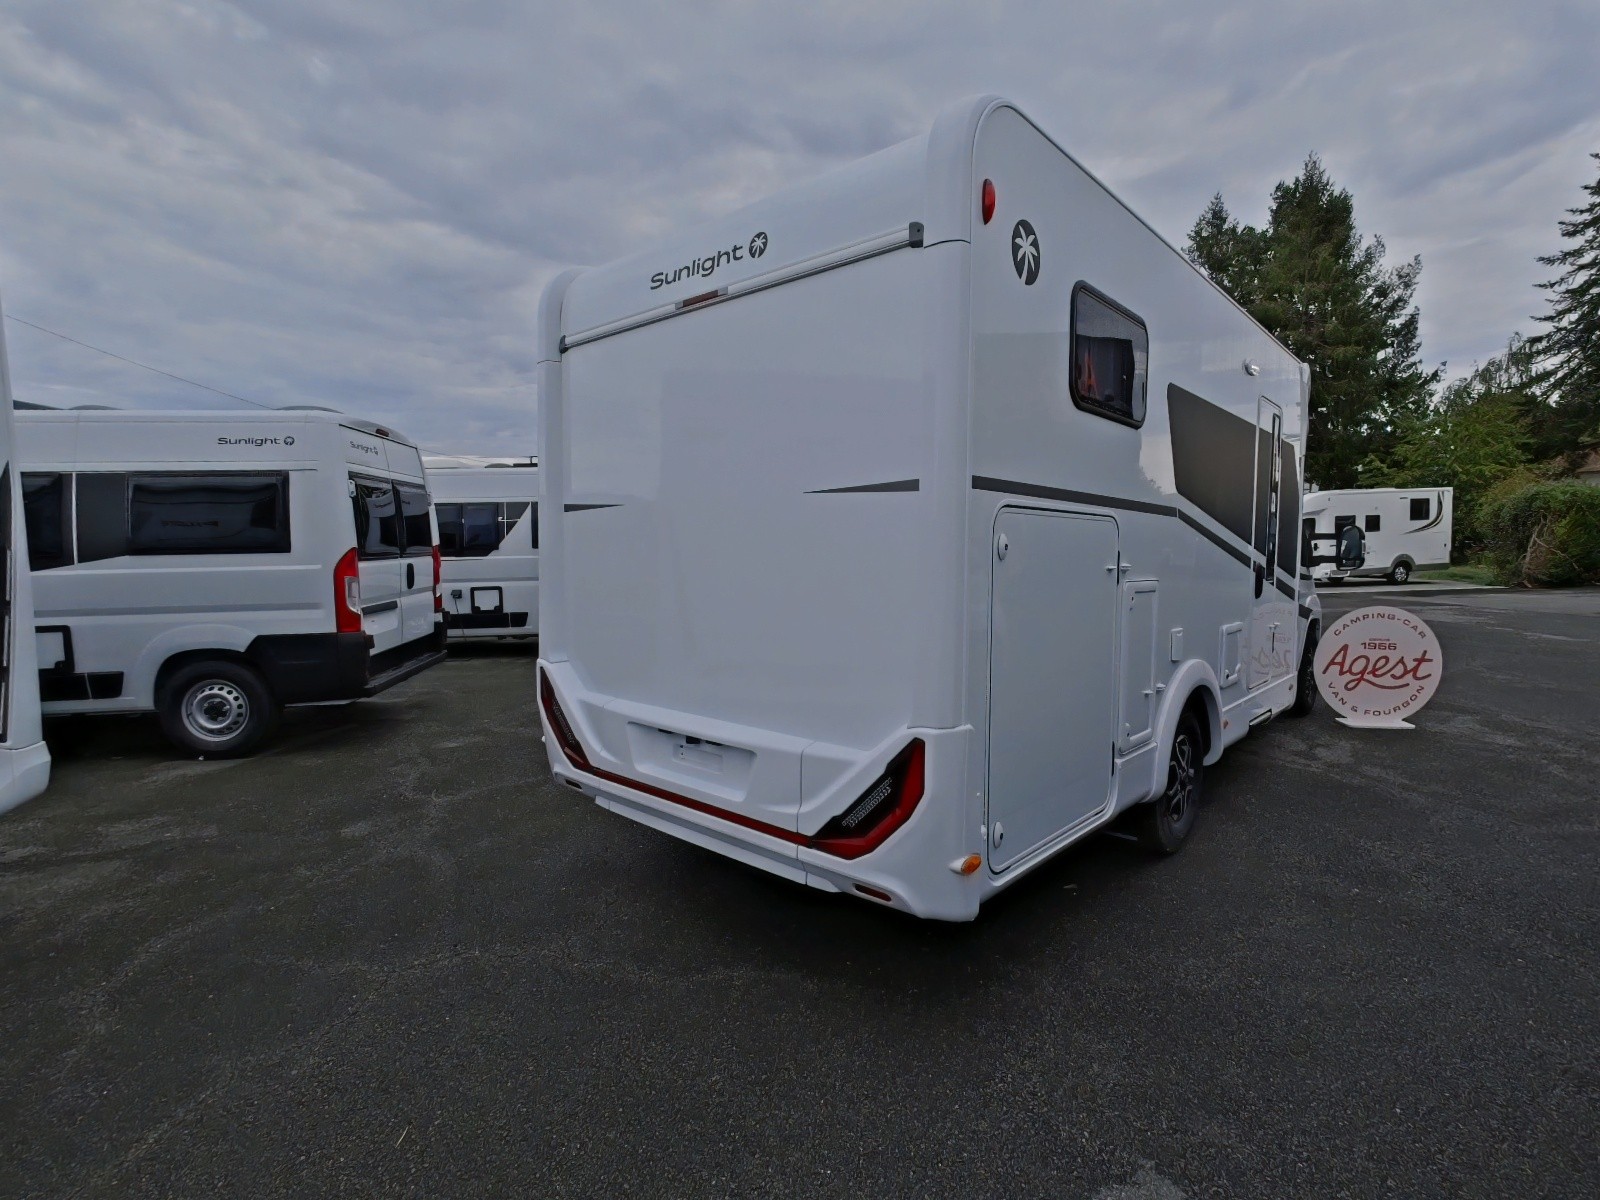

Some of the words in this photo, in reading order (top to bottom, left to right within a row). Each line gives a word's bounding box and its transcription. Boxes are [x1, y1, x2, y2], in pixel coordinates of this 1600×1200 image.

[650, 244, 743, 290] Sunlight
[217, 437, 281, 447] Sunlight
[1333, 612, 1427, 639] CAMPING-CAR
[1360, 642, 1397, 651] 1966
[1322, 643, 1433, 691] Agest
[1328, 682, 1347, 706] VAN
[1363, 685, 1425, 716] FOURGON
